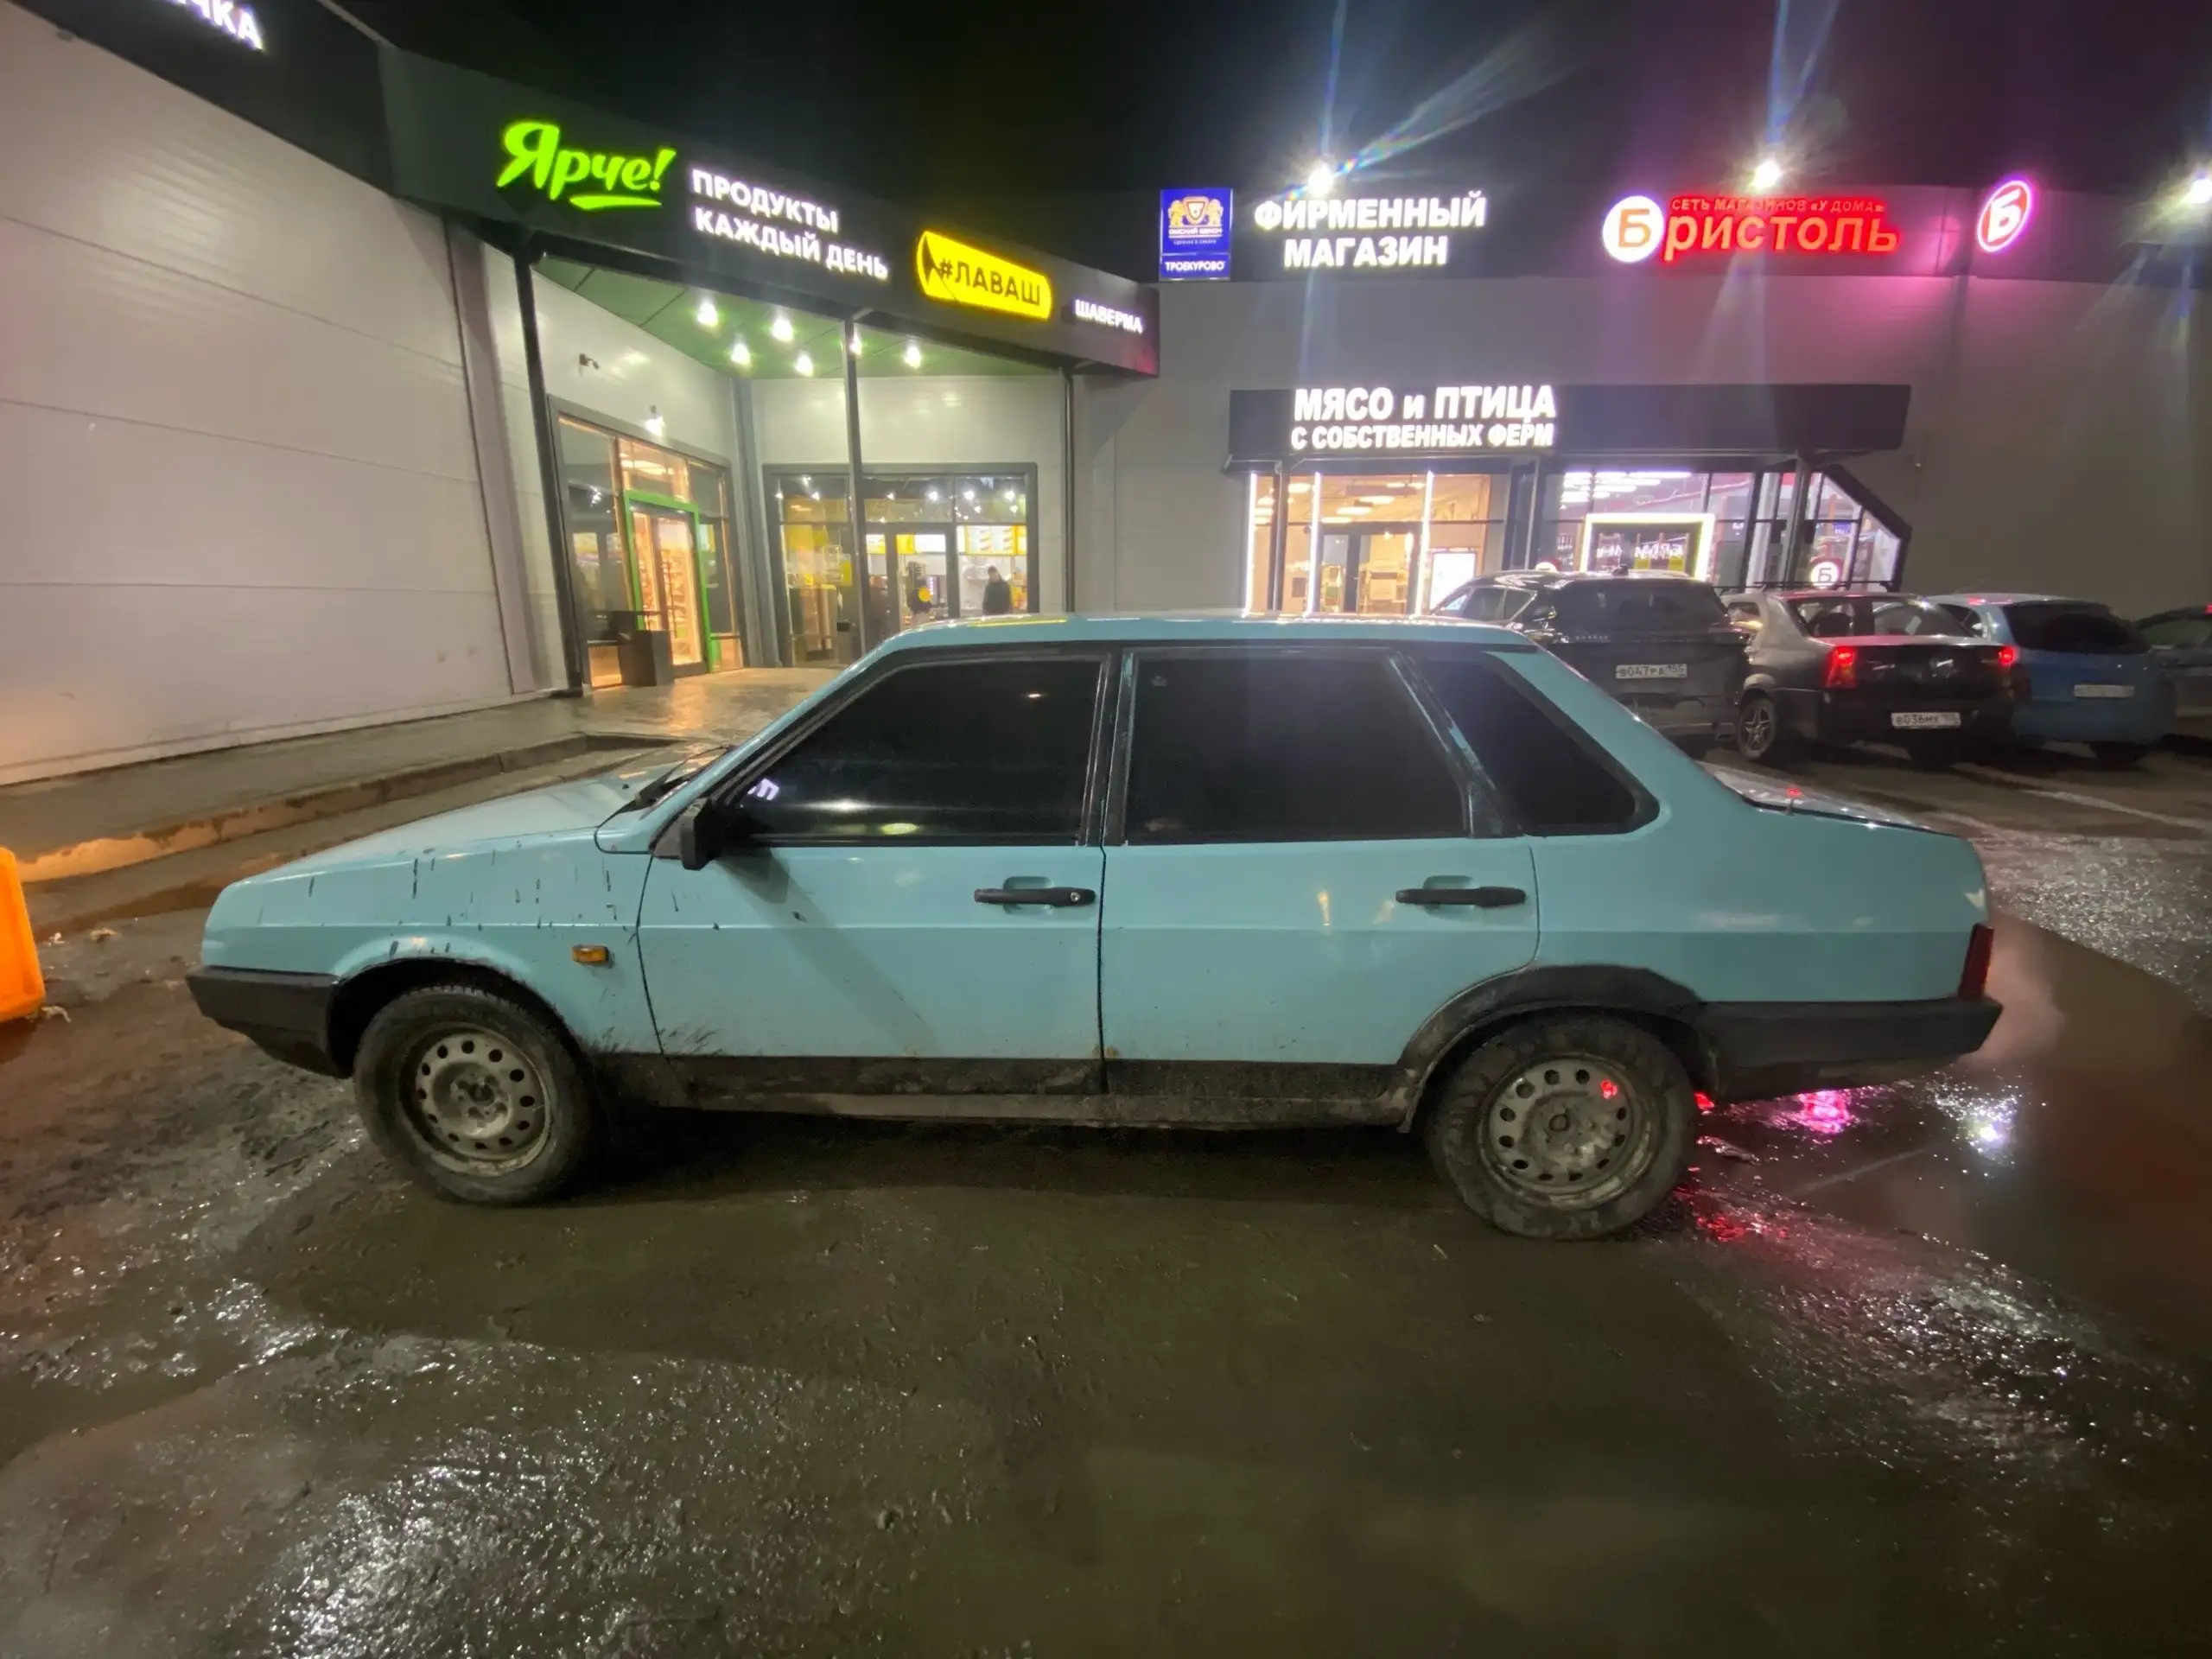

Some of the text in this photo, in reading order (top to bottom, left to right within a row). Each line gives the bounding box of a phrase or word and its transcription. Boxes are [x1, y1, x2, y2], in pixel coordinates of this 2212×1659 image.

[496, 121, 677, 200] Ярче!
[692, 168, 839, 233] ПРОДУКТЫ
[1254, 190, 1487, 230] ФИРМЕННЫЙ
[1670, 198, 1710, 211] СЕТЬ
[1713, 198, 1809, 212] МАГАЗИНОВ
[695, 207, 889, 281] КАЖДЫЙ ДЕНЬ
[1284, 236, 1448, 267] МАГАЗИН
[938, 257, 1040, 306] #ЛАВАШ
[1165, 260, 1225, 271] ТРОЕКУРОВО
[1075, 299, 1143, 334] ШАВЕРМА
[1294, 385, 1556, 423] МЯСО и ПТИЦА
[1291, 423, 1554, 448] С СОБСТВЕННЫХ ФЕРМ
